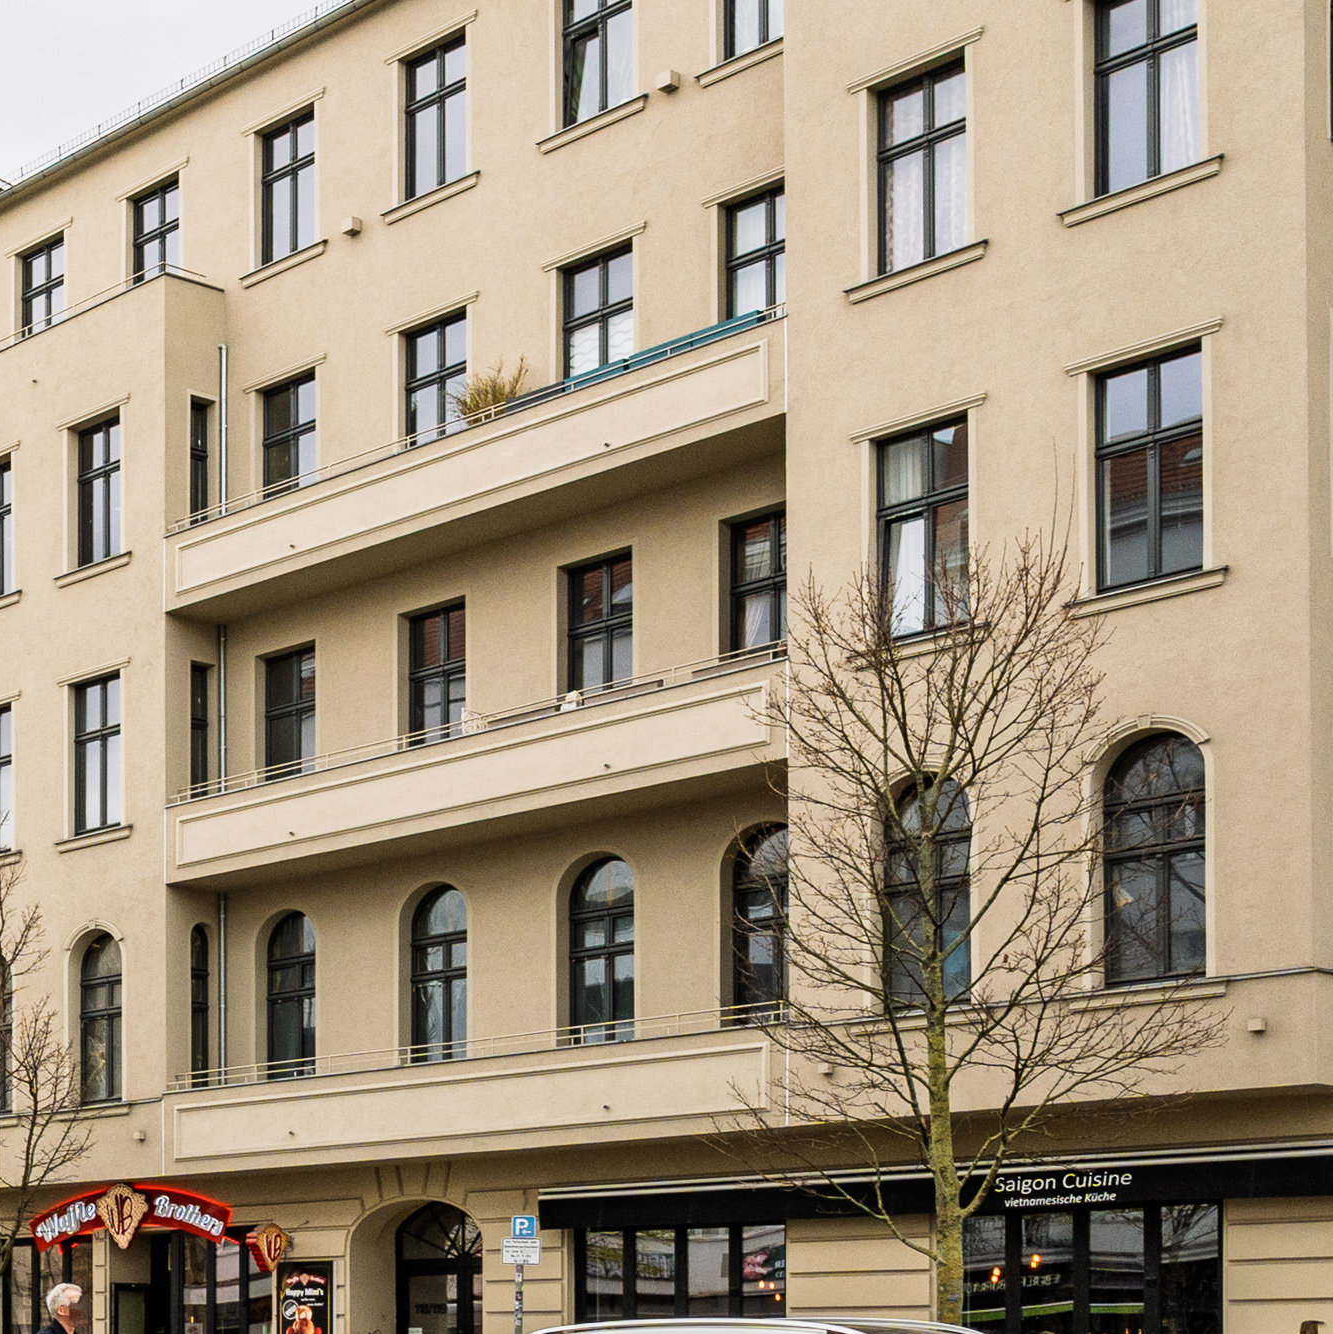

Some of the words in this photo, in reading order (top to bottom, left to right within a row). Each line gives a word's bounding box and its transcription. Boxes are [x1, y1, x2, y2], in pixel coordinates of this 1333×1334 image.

[994, 1176, 1056, 1195] Saigon
[1062, 1171, 1133, 1189] Cuisine
[1004, 1194, 1083, 1208] vietnamesische
[1084, 1191, 1117, 1203] Küche
[36, 1201, 97, 1243] Waffle
[154, 1195, 225, 1237] Brothers
[515, 1218, 529, 1235] P
